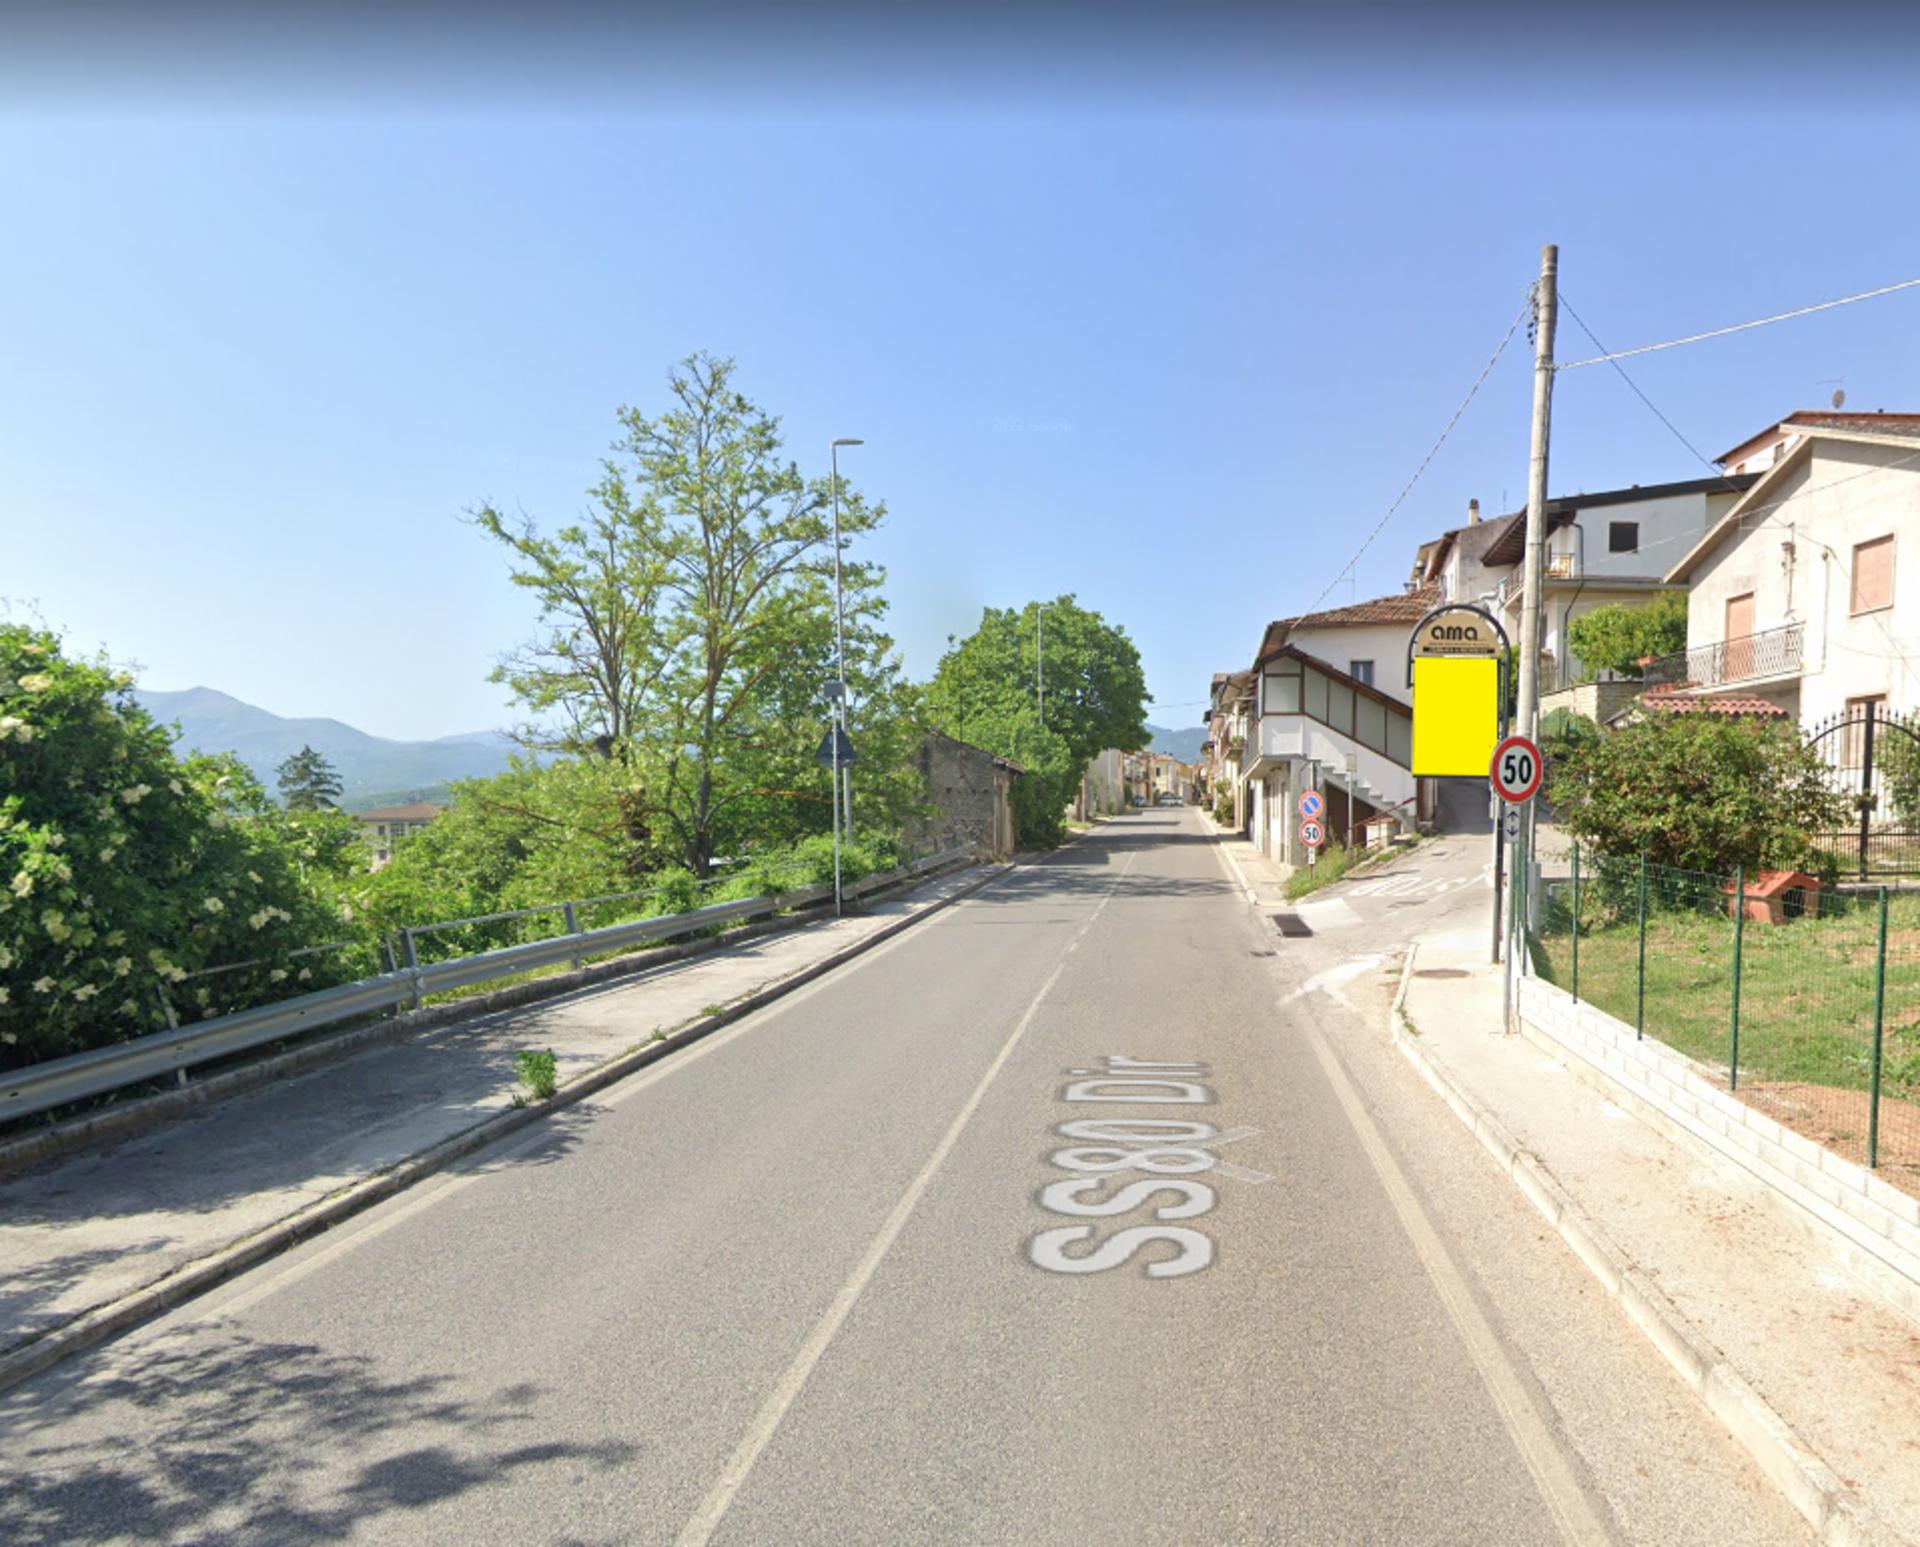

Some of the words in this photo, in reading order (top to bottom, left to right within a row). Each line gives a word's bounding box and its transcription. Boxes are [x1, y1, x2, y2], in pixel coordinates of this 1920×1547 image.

[1430, 625, 1478, 641] ama
[1503, 754, 1533, 785] 50
[1304, 826, 1320, 840] 50
